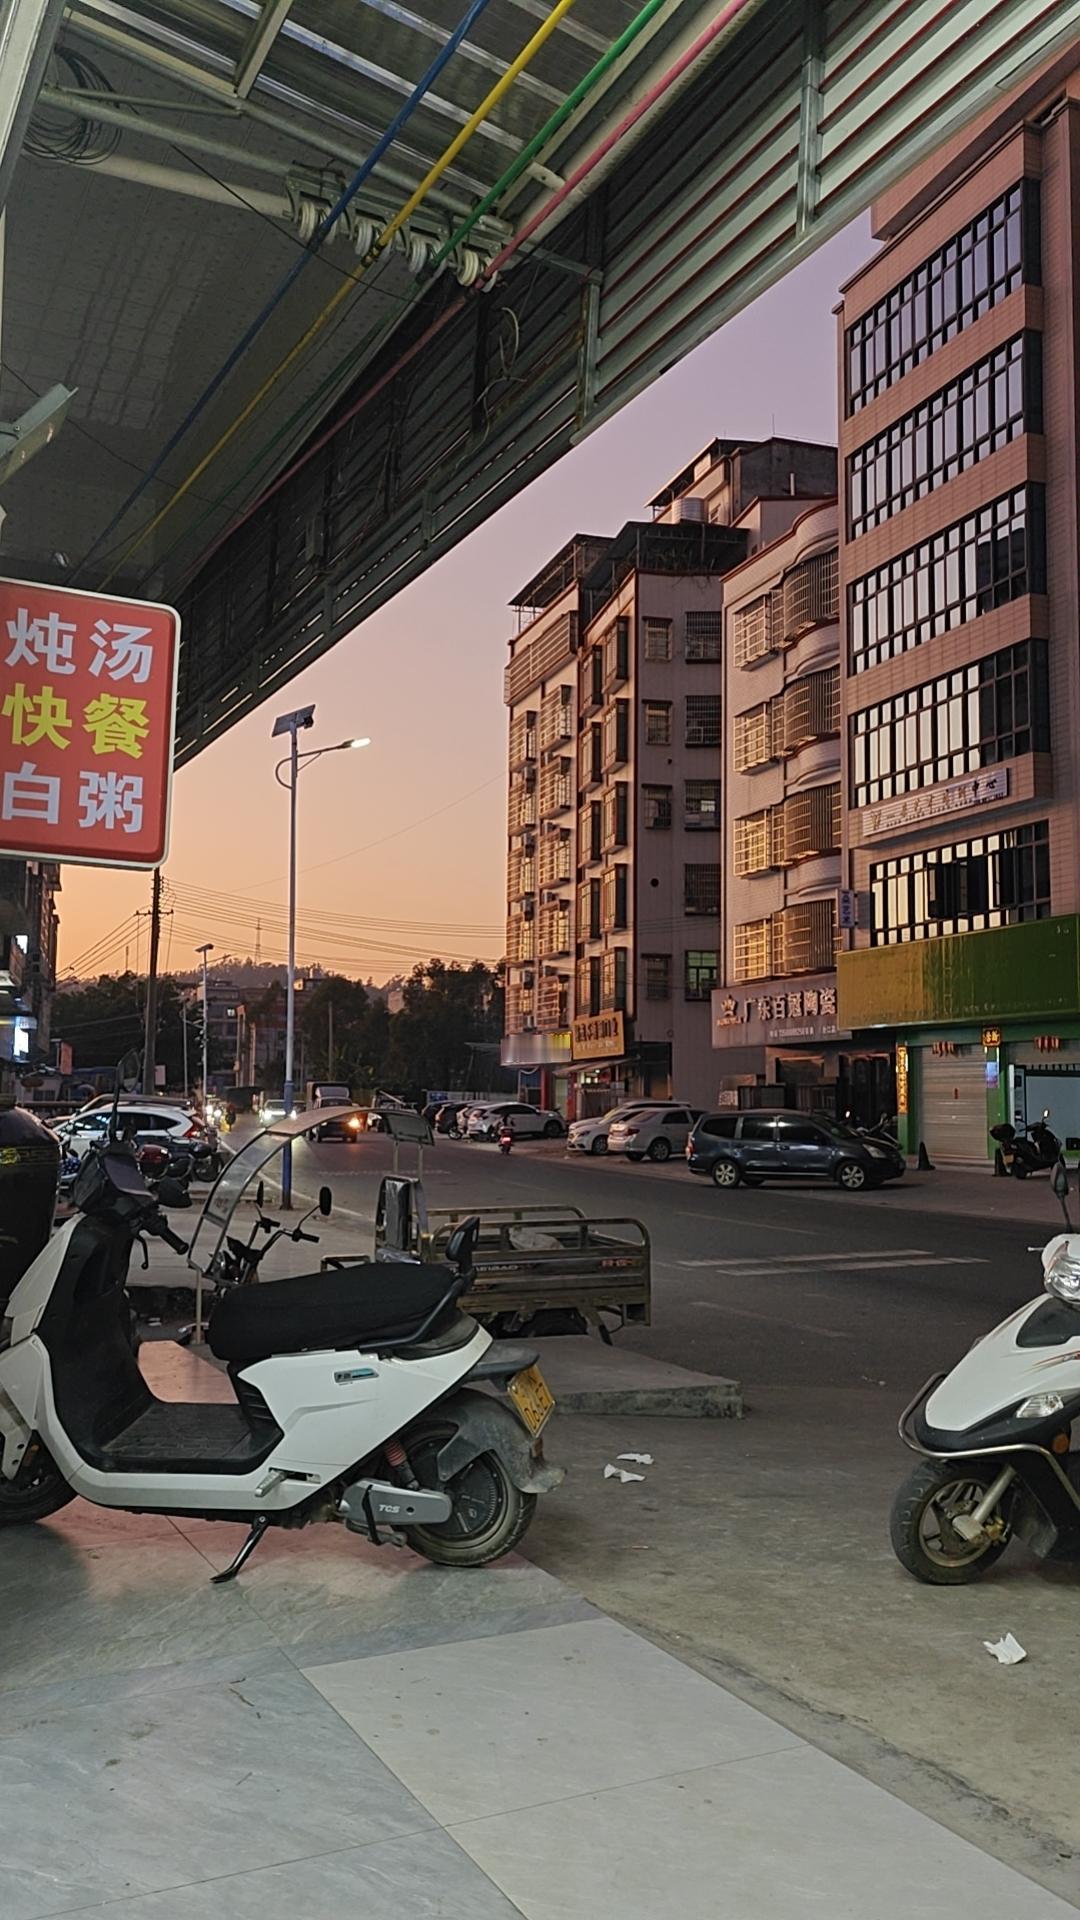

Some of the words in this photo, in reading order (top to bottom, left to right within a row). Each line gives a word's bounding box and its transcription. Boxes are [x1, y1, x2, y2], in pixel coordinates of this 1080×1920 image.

[5, 607, 153, 683] 炖汤
[1, 682, 150, 759] 快餐
[1, 761, 144, 833] 白粥
[378, 1504, 401, 1514] TCS
